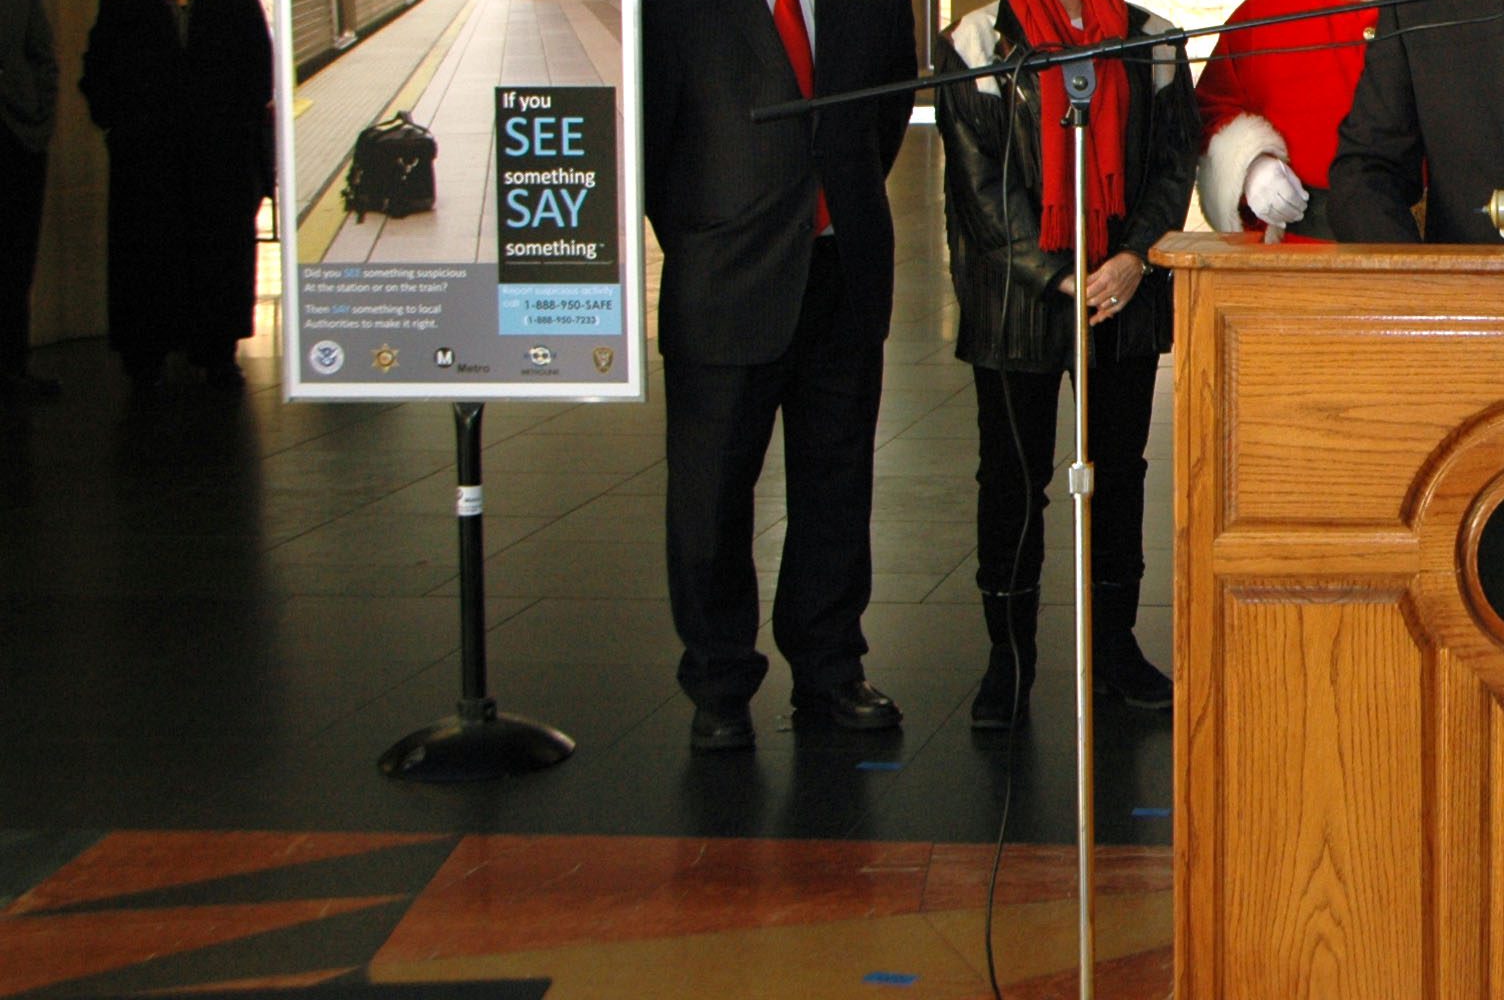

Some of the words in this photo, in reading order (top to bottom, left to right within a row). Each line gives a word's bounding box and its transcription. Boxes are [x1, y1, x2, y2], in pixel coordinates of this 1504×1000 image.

[503, 92, 516, 108] If
[519, 95, 551, 112] you
[505, 117, 585, 156] SEE
[504, 168, 596, 188] something
[506, 188, 588, 228] SAY
[506, 239, 597, 259] something
[323, 270, 341, 280] you
[363, 268, 415, 280] something
[416, 268, 467, 280] suspicious
[317, 283, 334, 292] the
[337, 283, 370, 293] station
[385, 284, 399, 292] on
[400, 283, 417, 292] the
[419, 282, 448, 293] train?
[305, 305, 330, 314] Then
[352, 304, 404, 316] something
[406, 305, 417, 314] to
[418, 304, 442, 314] local
[525, 299, 613, 310] 1-888-950-SAFE
[304, 319, 360, 329] Authorities
[361, 320, 373, 329] to
[375, 319, 401, 329] make
[403, 319, 411, 329] it
[436, 350, 453, 366] M
[457, 363, 490, 373] Metro
